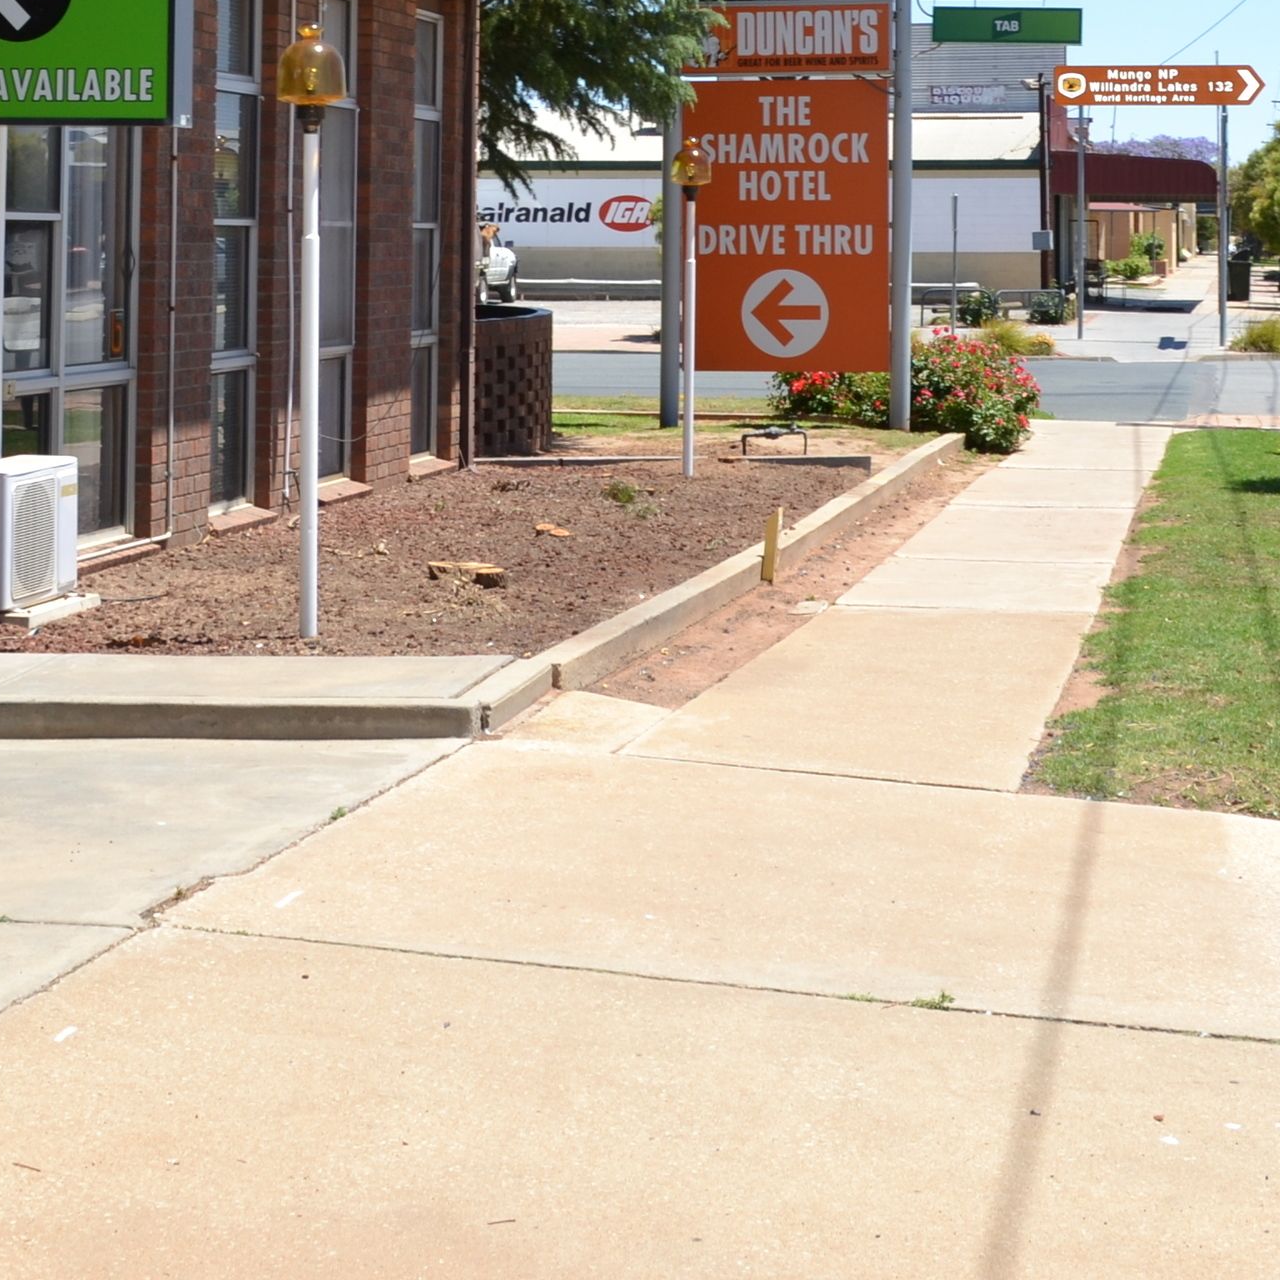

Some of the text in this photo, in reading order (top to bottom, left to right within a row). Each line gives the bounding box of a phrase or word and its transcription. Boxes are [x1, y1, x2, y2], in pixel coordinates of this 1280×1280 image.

[737, 9, 879, 56] DUNCAN'S
[994, 19, 1020, 33] TAB
[1088, 81, 1234, 93] Willandra Lakes 132
[1106, 69, 1179, 81] Mungo NP
[758, 96, 811, 126] THE
[1093, 94, 1196, 104] World Heritage Area
[700, 132, 869, 164] SHAMROCK
[738, 170, 832, 201] HOTEL
[603, 200, 652, 225] IGA
[698, 225, 873, 255] DRIVE THRU
